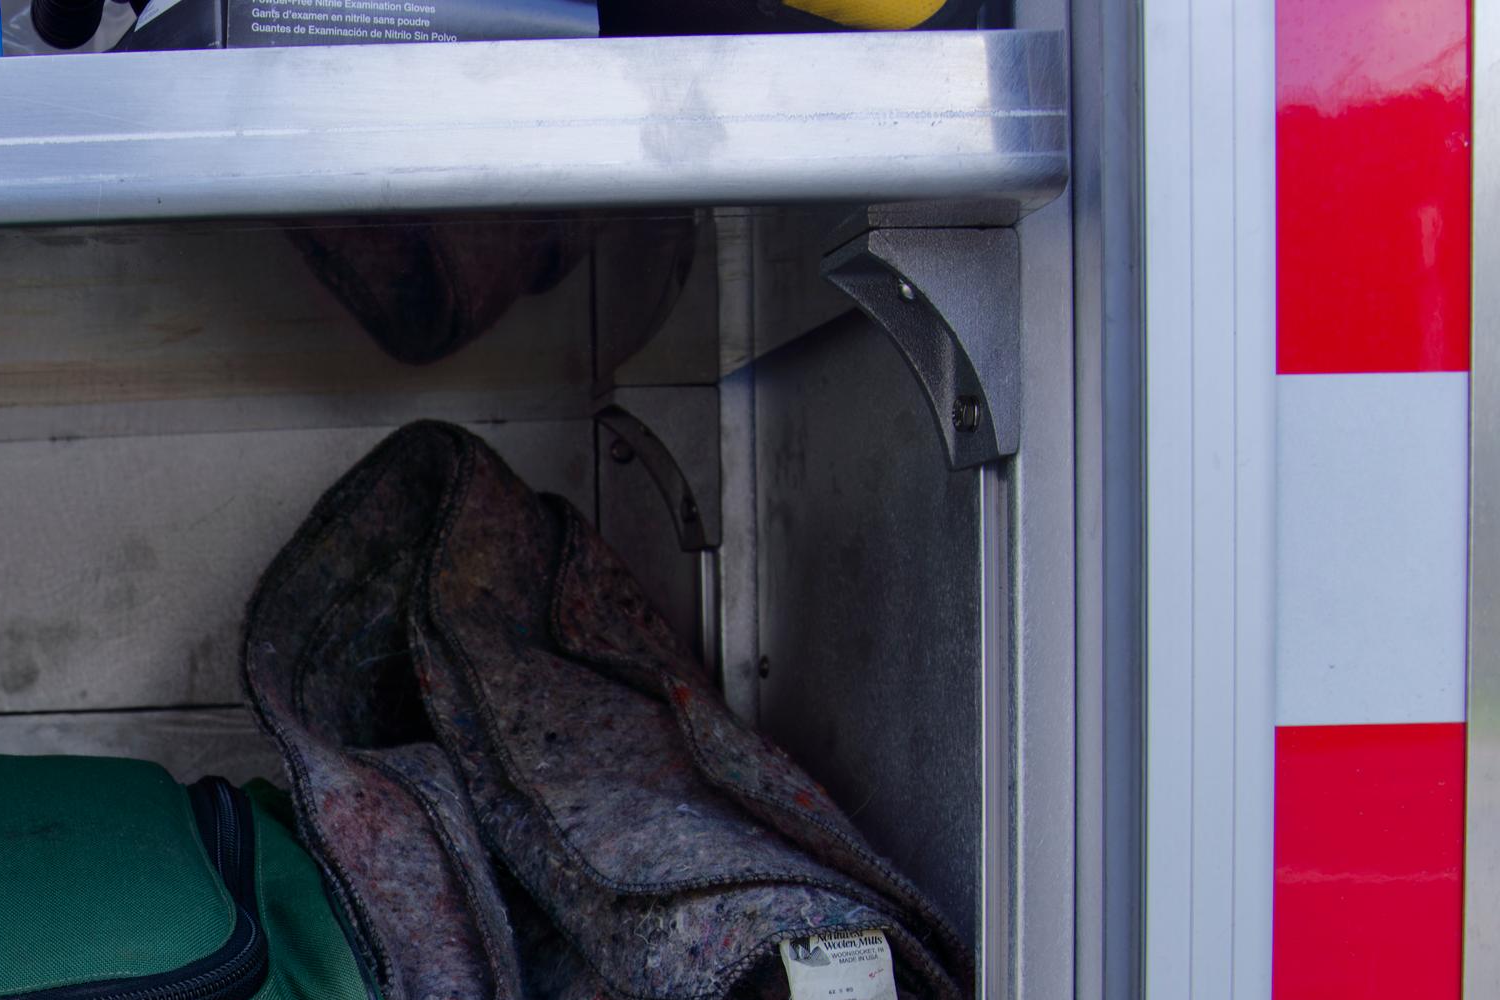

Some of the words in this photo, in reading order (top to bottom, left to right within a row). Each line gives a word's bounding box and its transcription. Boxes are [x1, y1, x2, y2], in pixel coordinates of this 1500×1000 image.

[344, 0, 402, 11] Examination
[403, 2, 436, 13] Gloves
[251, 8, 280, 19] Gants
[282, 9, 328, 20] d'examen
[331, 14, 343, 22] en
[345, 13, 371, 24] nitrile
[373, 16, 395, 25] sans
[397, 17, 430, 27] poudre
[251, 22, 291, 33] Guantes
[293, 24, 306, 34] de
[308, 25, 368, 37] Examinación
[370, 29, 382, 38] de
[384, 29, 412, 40] Nitrilo
[414, 31, 429, 41] Sin
[431, 32, 457, 43] Polvo
[858, 935, 883, 949] Mills
